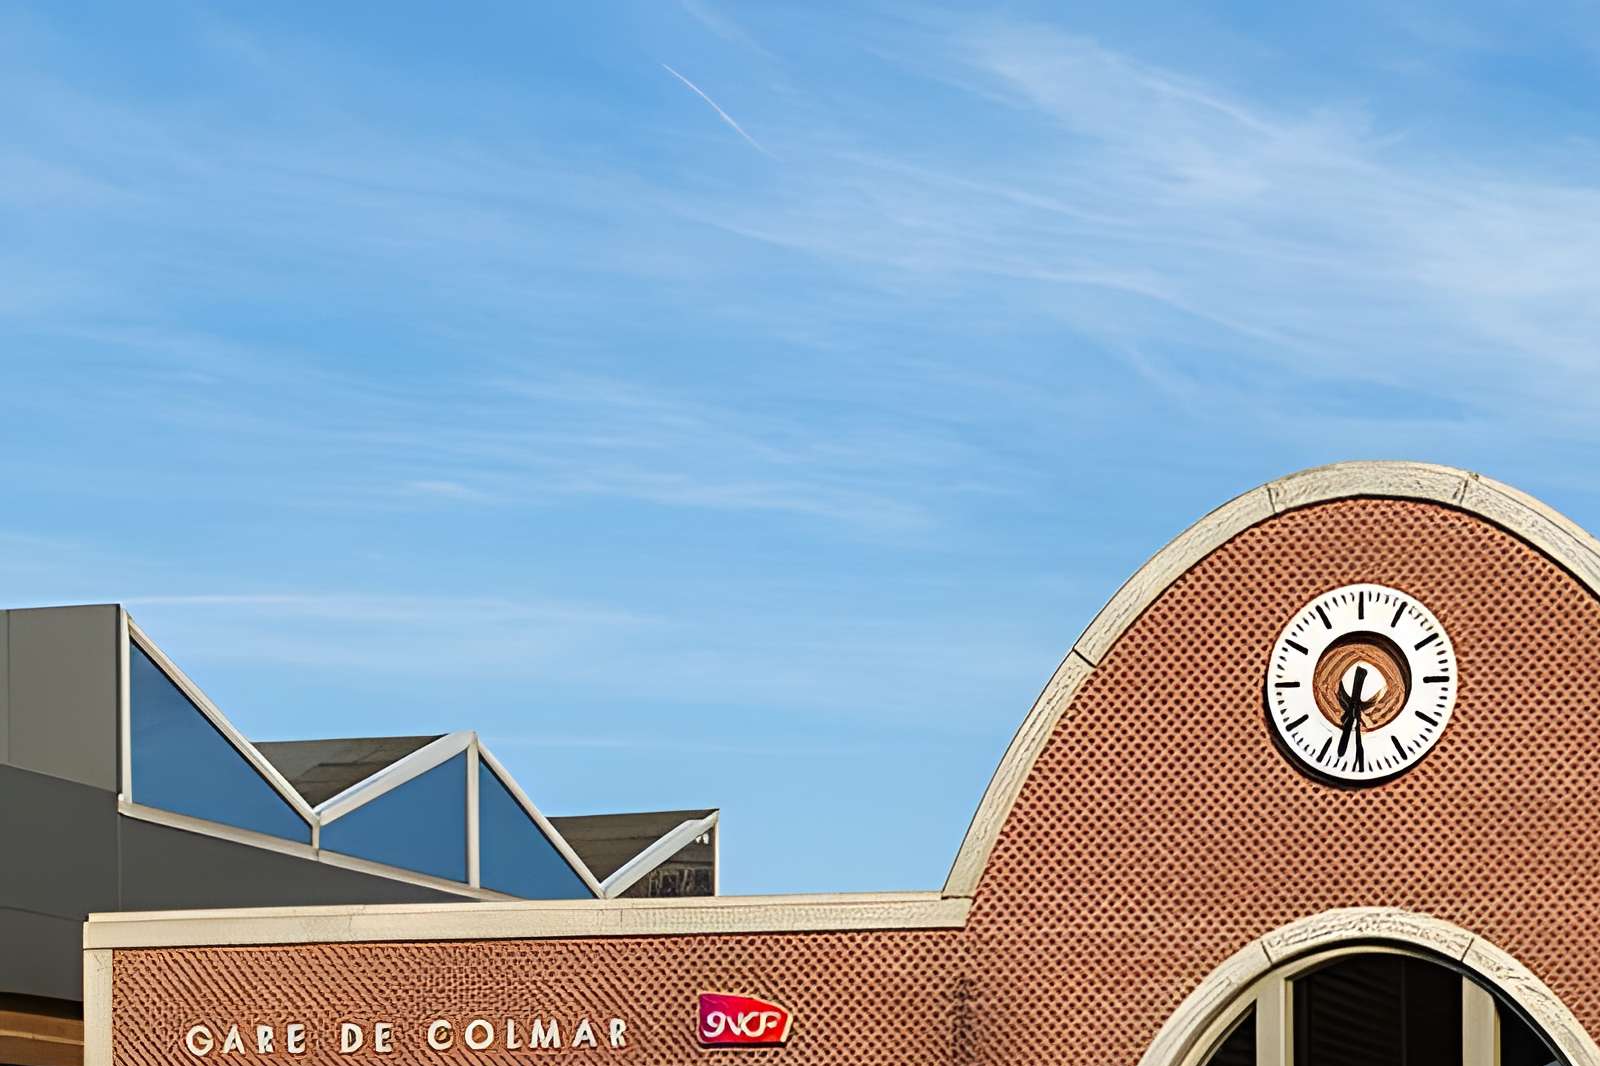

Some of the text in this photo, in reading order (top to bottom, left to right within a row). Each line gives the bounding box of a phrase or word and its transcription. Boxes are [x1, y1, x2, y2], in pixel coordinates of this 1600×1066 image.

[185, 1018, 627, 1056] GARE DE COLMAR
[703, 1010, 782, 1038] SNCF
